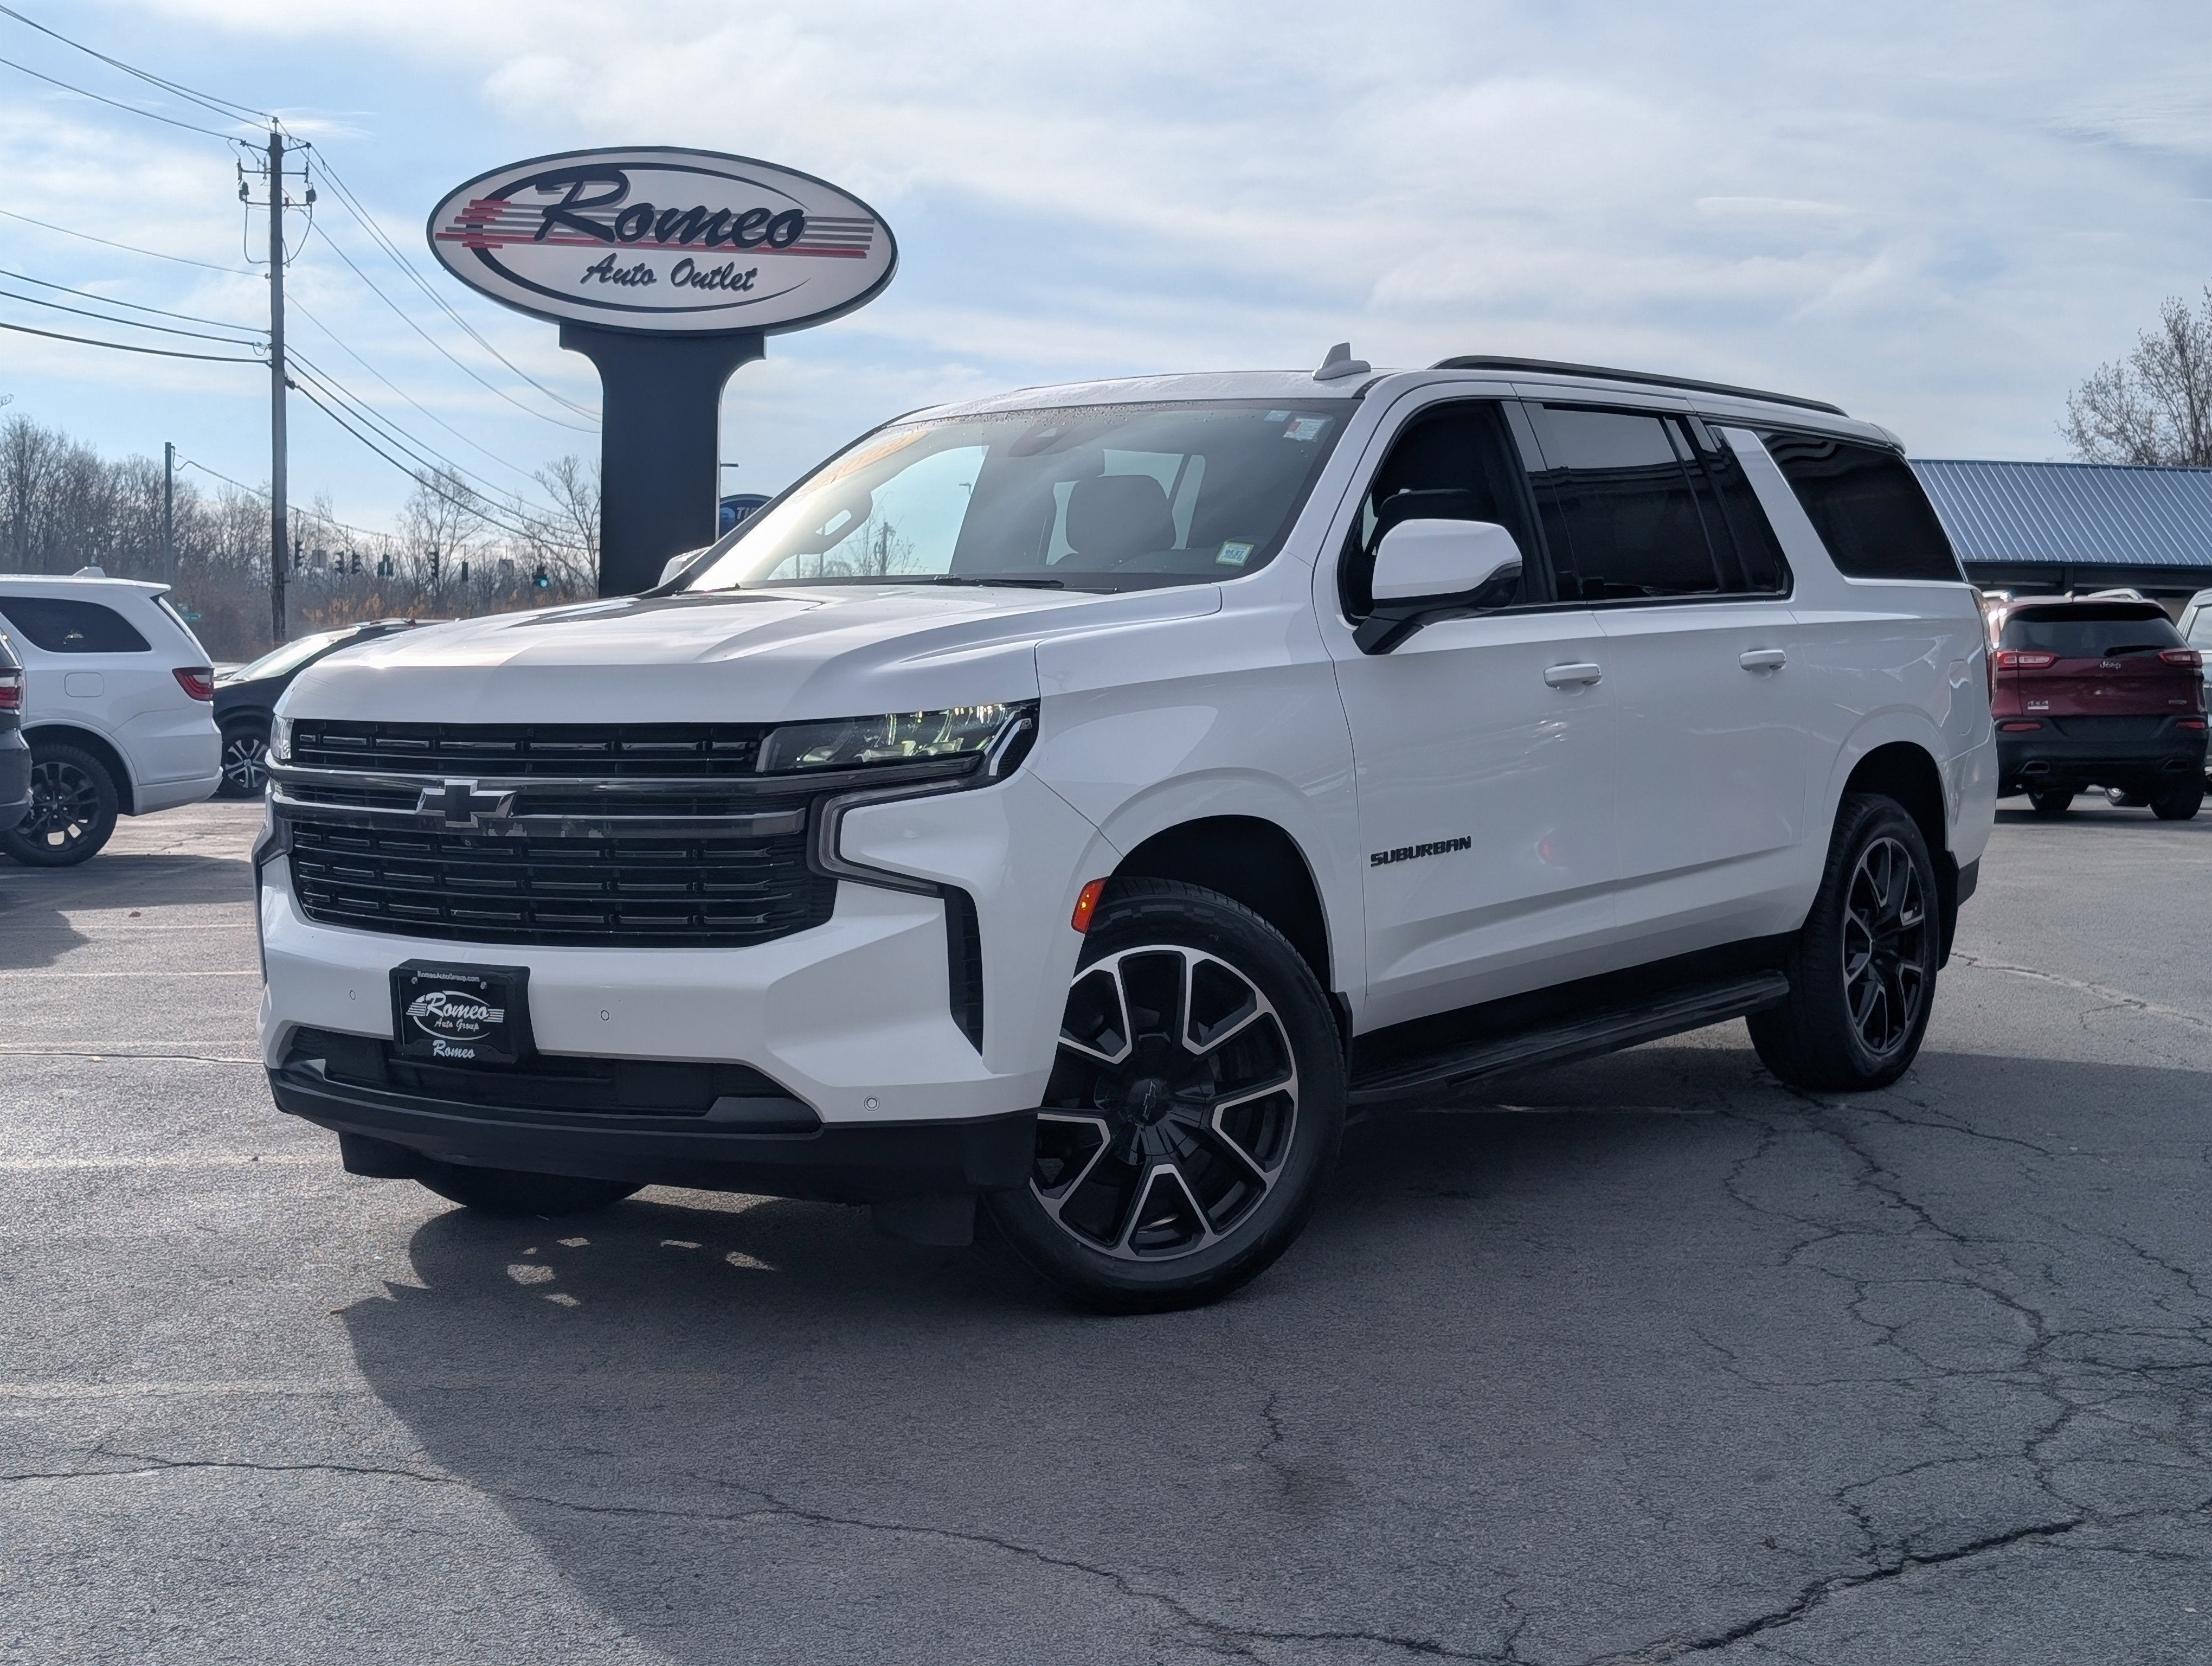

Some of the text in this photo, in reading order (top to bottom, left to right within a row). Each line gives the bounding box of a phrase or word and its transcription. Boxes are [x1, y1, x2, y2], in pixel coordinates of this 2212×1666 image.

[534, 164, 806, 249] Romeo
[580, 253, 758, 291] Auto Outlet
[1371, 836, 1471, 867] SUBURBAN
[425, 992, 489, 1020] Romeo
[434, 1017, 479, 1032] Auto Group
[433, 1040, 475, 1059] Romeo
